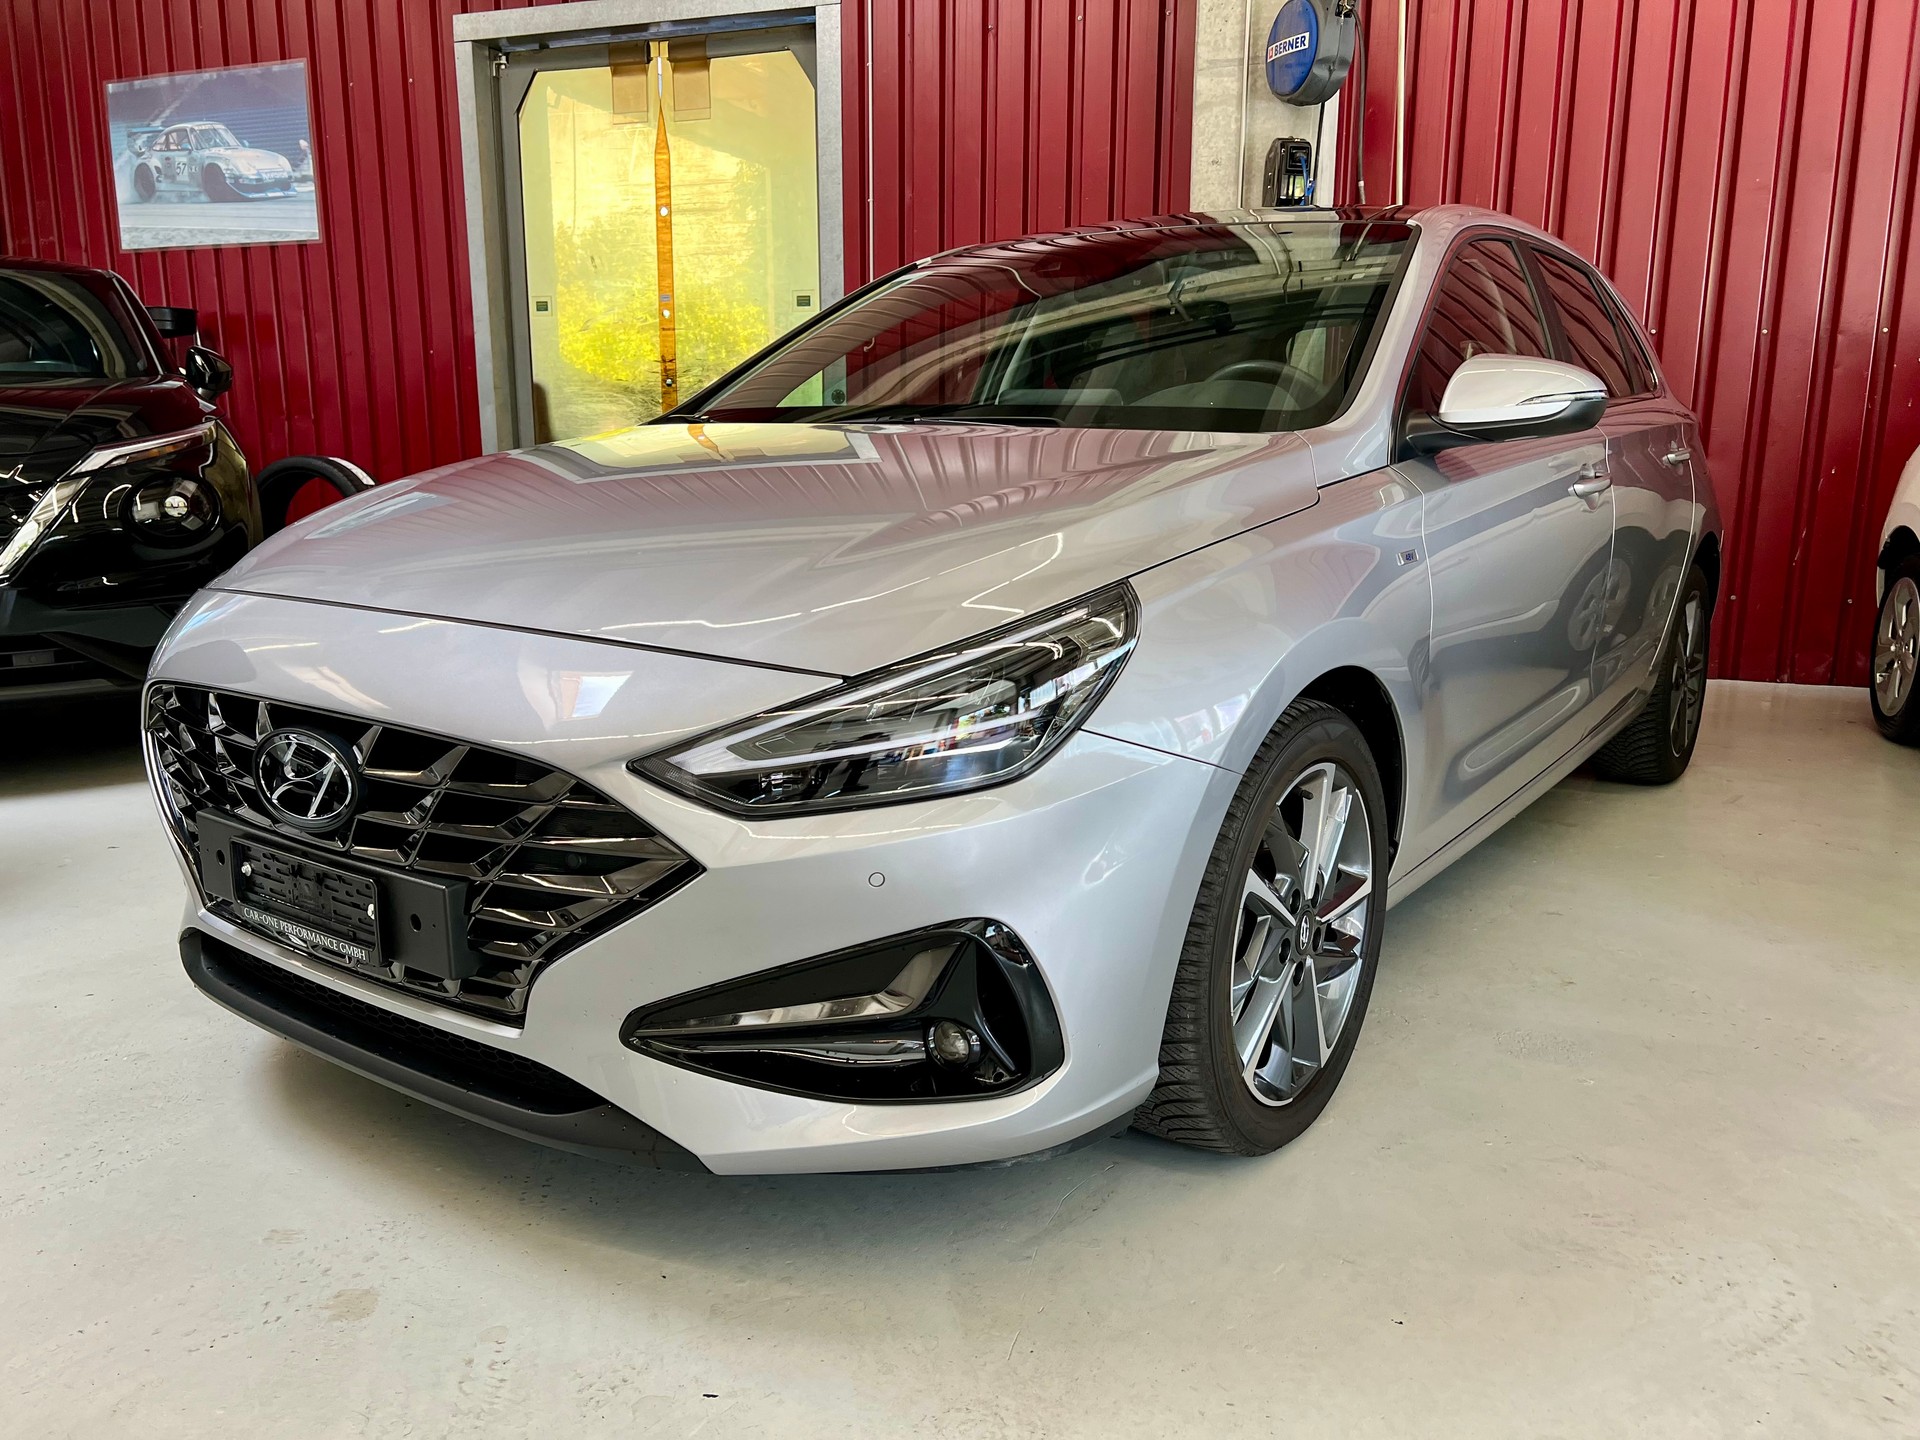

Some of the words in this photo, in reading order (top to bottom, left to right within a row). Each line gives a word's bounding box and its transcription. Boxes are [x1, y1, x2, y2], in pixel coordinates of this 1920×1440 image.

[1274, 36, 1306, 56] BERNER
[176, 162, 187, 175] 57
[244, 908, 279, 928] CAR-ONE
[280, 921, 338, 950] PERFORMANCE
[340, 943, 366, 961] GMBH
